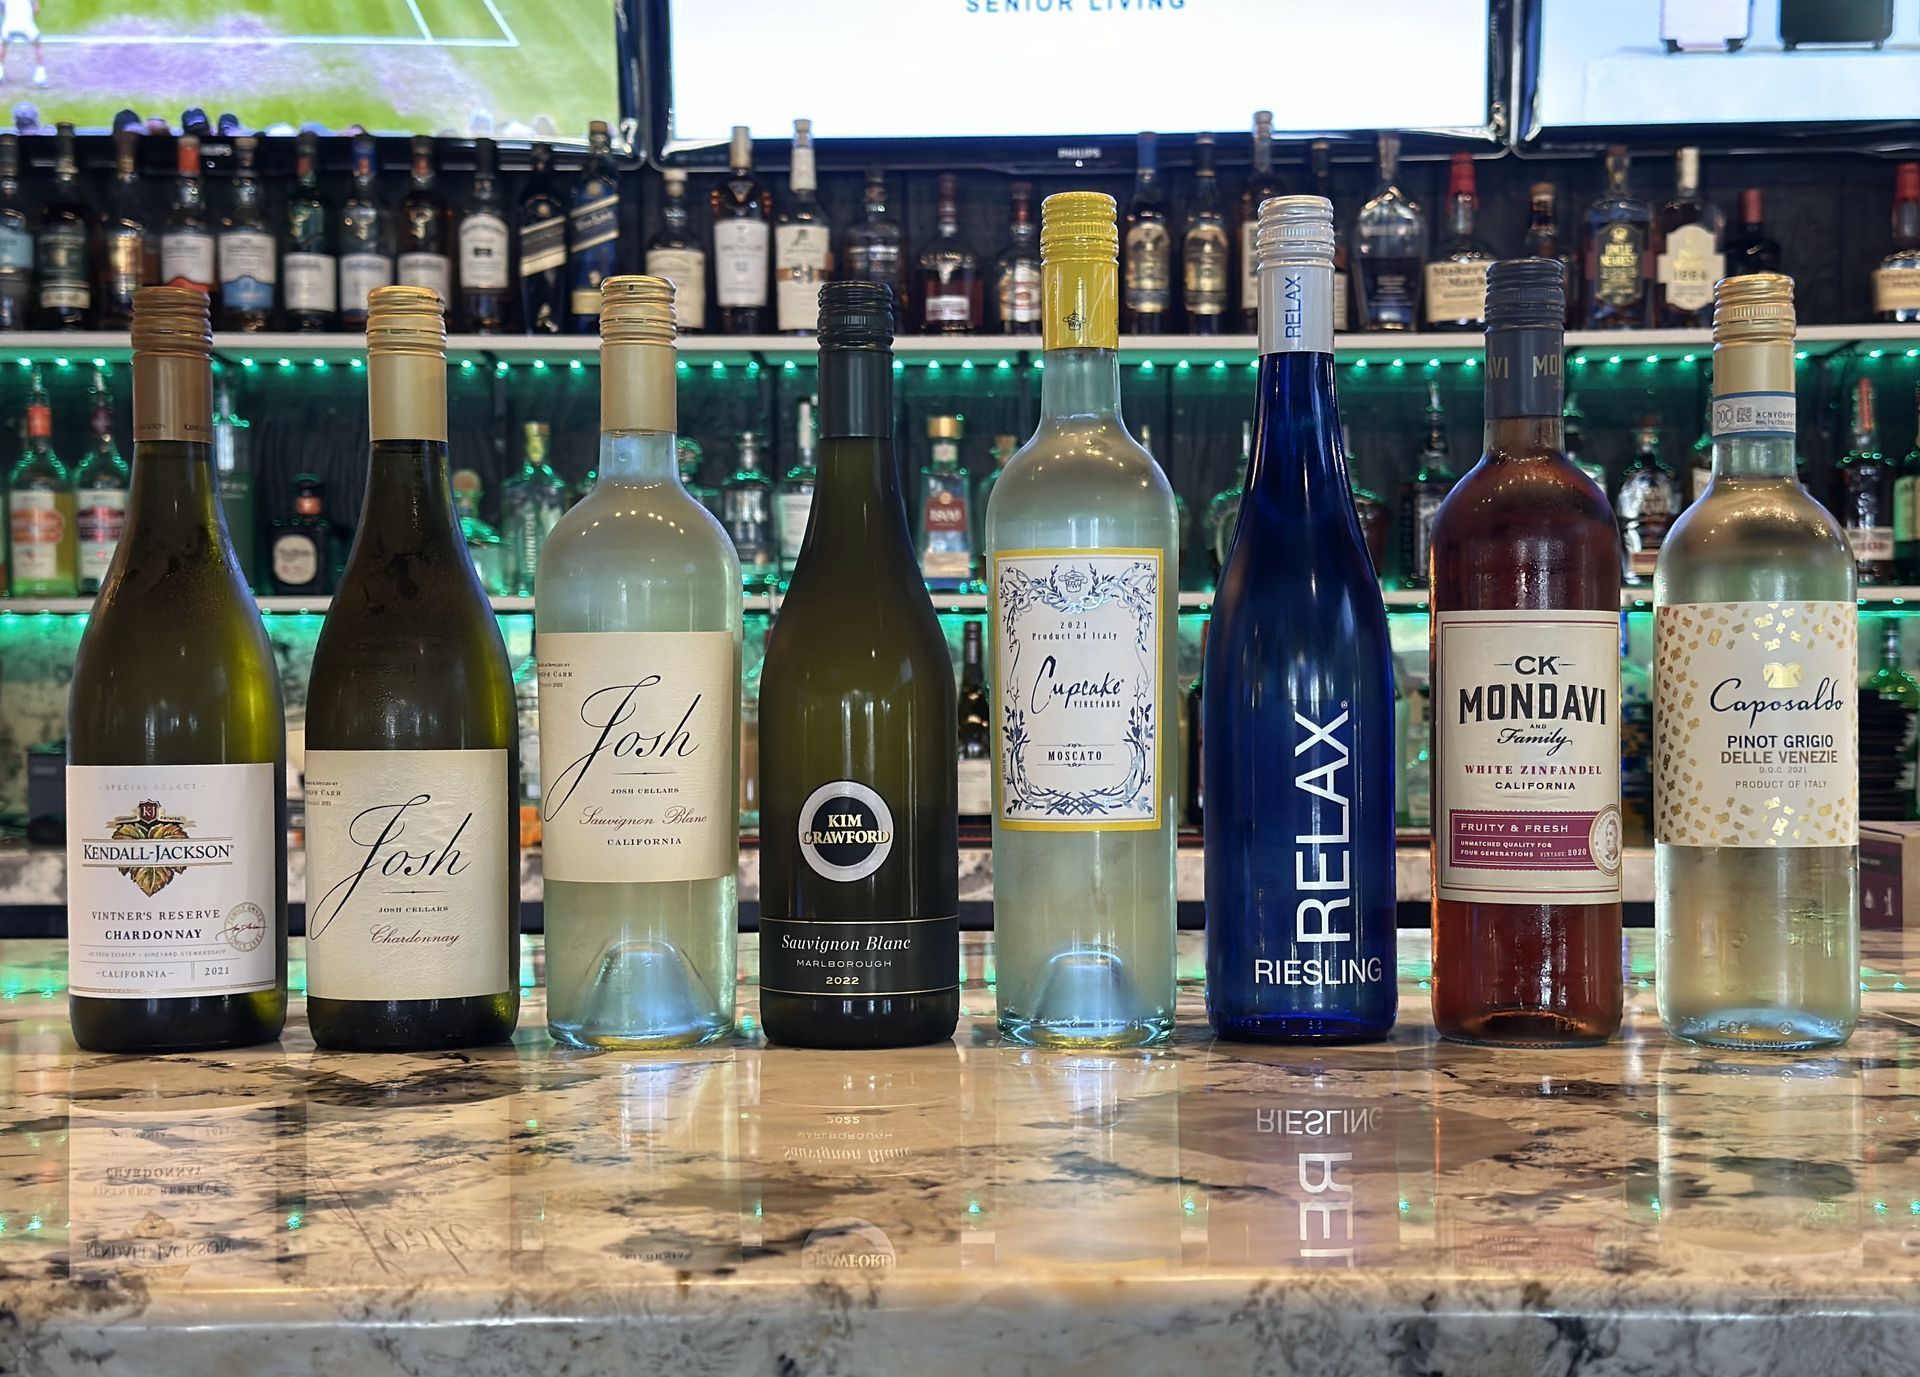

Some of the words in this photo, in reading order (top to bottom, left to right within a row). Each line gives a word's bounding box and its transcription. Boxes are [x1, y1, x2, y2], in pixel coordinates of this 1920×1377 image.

[966, 0, 1073, 12] SENIOR
[1090, 0, 1185, 11] LIVING
[1057, 148, 1102, 158] PHILIPS
[1285, 276, 1301, 339] RELAX
[1060, 621, 1088, 630] 2021
[1032, 632, 1071, 641] Product
[1076, 632, 1087, 640] of
[1092, 631, 1118, 641] Italy
[1514, 655, 1559, 676] CK
[1031, 655, 1121, 715] Cupcake
[1073, 700, 1121, 708] VINEYARDS
[1459, 682, 1607, 725] MONDAVI
[1710, 677, 1844, 729] Caposaldo
[1497, 728, 1573, 757] Family
[1727, 735, 1778, 749] PINOT
[1783, 734, 1834, 748] GRIGIO
[544, 674, 702, 823] Josh
[1048, 751, 1103, 761] MOSCATO
[1721, 751, 1772, 764] DELLE
[1778, 750, 1838, 764] VENEZIE
[1465, 764, 1513, 775] WHITE
[1520, 764, 1602, 776] ZINFANDEL
[637, 787, 679, 795] CELLARS
[1495, 781, 1576, 790] CALIFORNIA
[1735, 781, 1784, 789] PRODUCT
[1788, 781, 1801, 789] OF
[1804, 780, 1828, 789] ITALY
[579, 806, 654, 831] Sauvignon
[662, 805, 707, 825] Blanc
[828, 814, 863, 828] KIM
[1294, 710, 1350, 943] RELAX
[1461, 822, 1505, 833] FRUITY
[1510, 824, 1520, 833] &
[1525, 824, 1569, 833] FRESH
[607, 838, 682, 847] CALIFORNIA
[802, 830, 891, 845] CRAWFORD
[1460, 840, 1501, 848] UNMATCHED
[1503, 841, 1535, 849] QUALITY
[84, 844, 231, 863] KENDALL-JACKSON
[1567, 848, 1587, 857] 2020
[310, 793, 473, 941] Josh
[91, 911, 153, 922] VINTNER'S
[159, 909, 220, 921] RESERVE
[105, 929, 202, 941] CHARDONNAY
[369, 924, 460, 947] Chardonnay
[782, 934, 860, 954] Sauvignon
[864, 935, 911, 951] Blanc
[796, 959, 892, 968] MARLBOROUGH
[102, 970, 167, 979] CALIFORNIA
[204, 967, 230, 977] 2021
[1255, 957, 1382, 985] RIESLING
[825, 976, 859, 985] 2022
